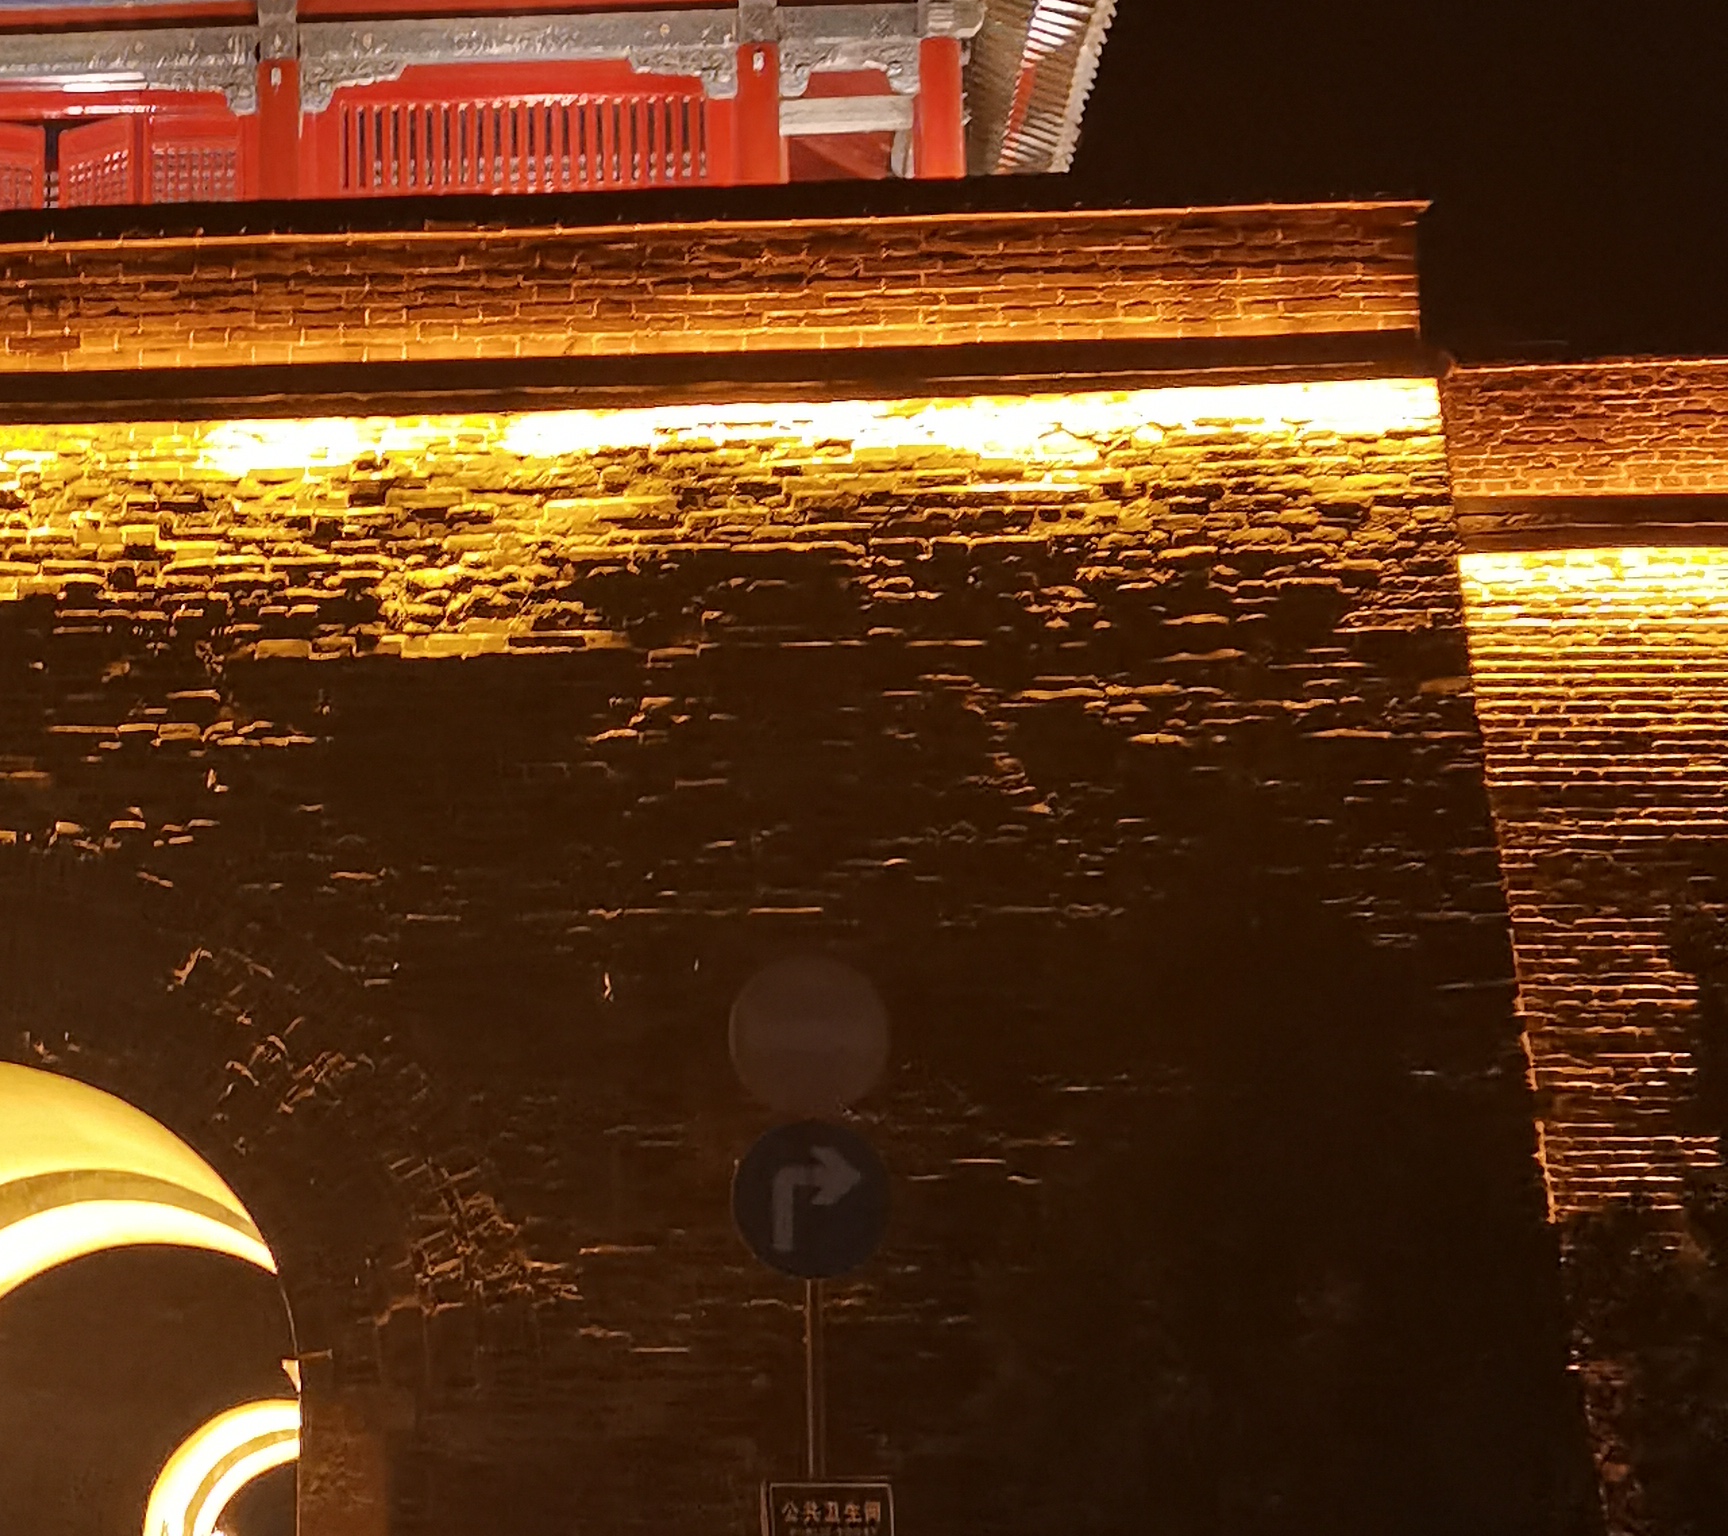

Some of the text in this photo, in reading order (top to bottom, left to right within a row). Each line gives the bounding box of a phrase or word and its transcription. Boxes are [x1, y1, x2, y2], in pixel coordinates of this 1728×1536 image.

[781, 1500, 881, 1524] 公共卫生间
